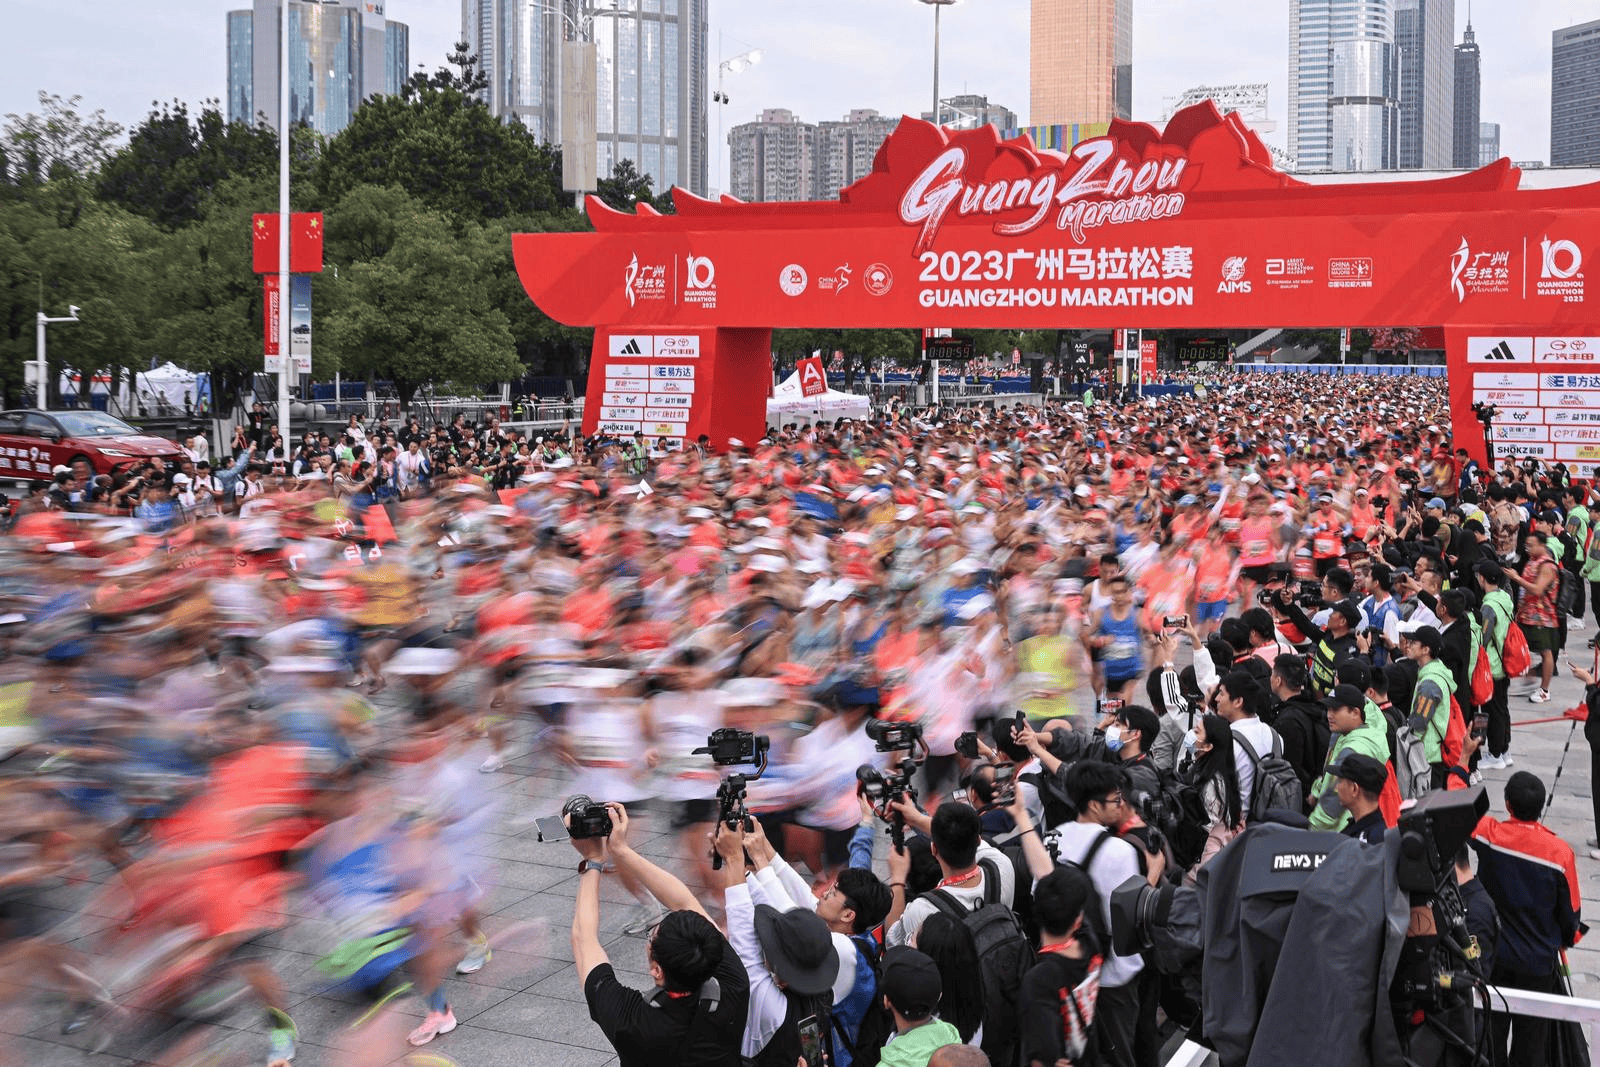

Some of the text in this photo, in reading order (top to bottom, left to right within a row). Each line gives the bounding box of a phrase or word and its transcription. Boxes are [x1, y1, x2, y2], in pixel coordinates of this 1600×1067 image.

[900, 138, 1187, 252] GuangZhou
[1058, 193, 1184, 243] Marathon
[918, 246, 1193, 282] 2023广州马拉松赛
[1472, 251, 1510, 268] 广州
[639, 264, 666, 278] 广州
[1464, 267, 1509, 279] 马拉松
[1217, 280, 1251, 293] AIMS
[1537, 288, 1584, 296] MARATHON
[918, 285, 1194, 308] GUANGZHOU MARATHON
[929, 346, 970, 358] 0:00:59
[1179, 347, 1225, 360] 0:00:59
[668, 366, 692, 377] 易方达
[803, 362, 821, 383] A
[1566, 375, 1600, 388] 易方达
[1497, 445, 1528, 455] SHOKZ
